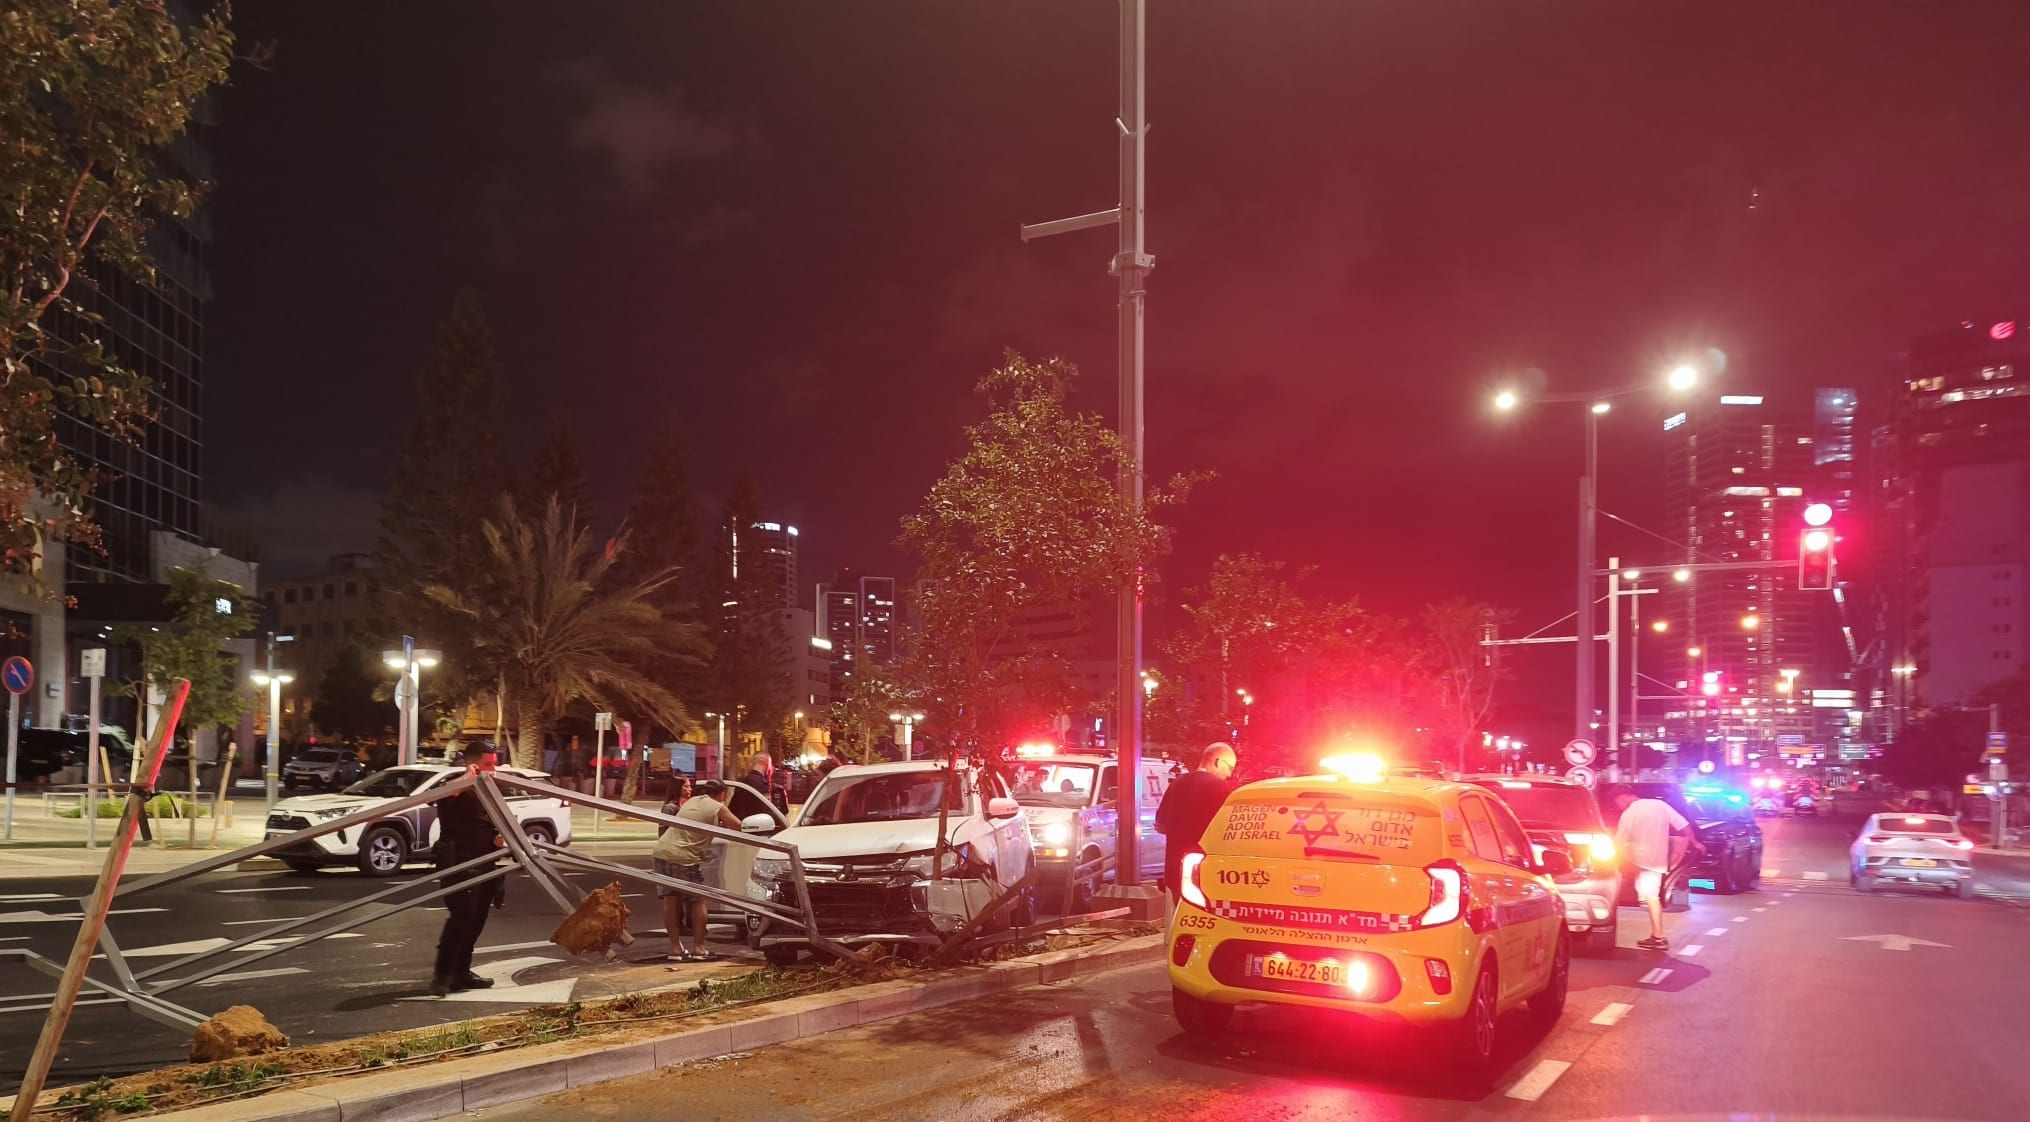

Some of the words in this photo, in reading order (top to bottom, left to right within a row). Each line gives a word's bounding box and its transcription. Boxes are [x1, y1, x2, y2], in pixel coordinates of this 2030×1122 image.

[1232, 804, 1277, 814] MAGEN
[1359, 807, 1384, 819] דוד
[1388, 809, 1415, 822] מגן
[1229, 813, 1267, 823] DAVID
[1225, 822, 1265, 832] ADOM
[1371, 820, 1413, 836] אדום
[1223, 831, 1237, 841] IN
[1240, 830, 1281, 841] ISRAEL
[1216, 869, 1250, 885] 101
[1239, 906, 1285, 921] מיידית
[1290, 910, 1332, 925] תגובה
[1179, 915, 1217, 930] 6355
[1242, 926, 1285, 937] הלאומי
[1289, 929, 1332, 942] ההצלה
